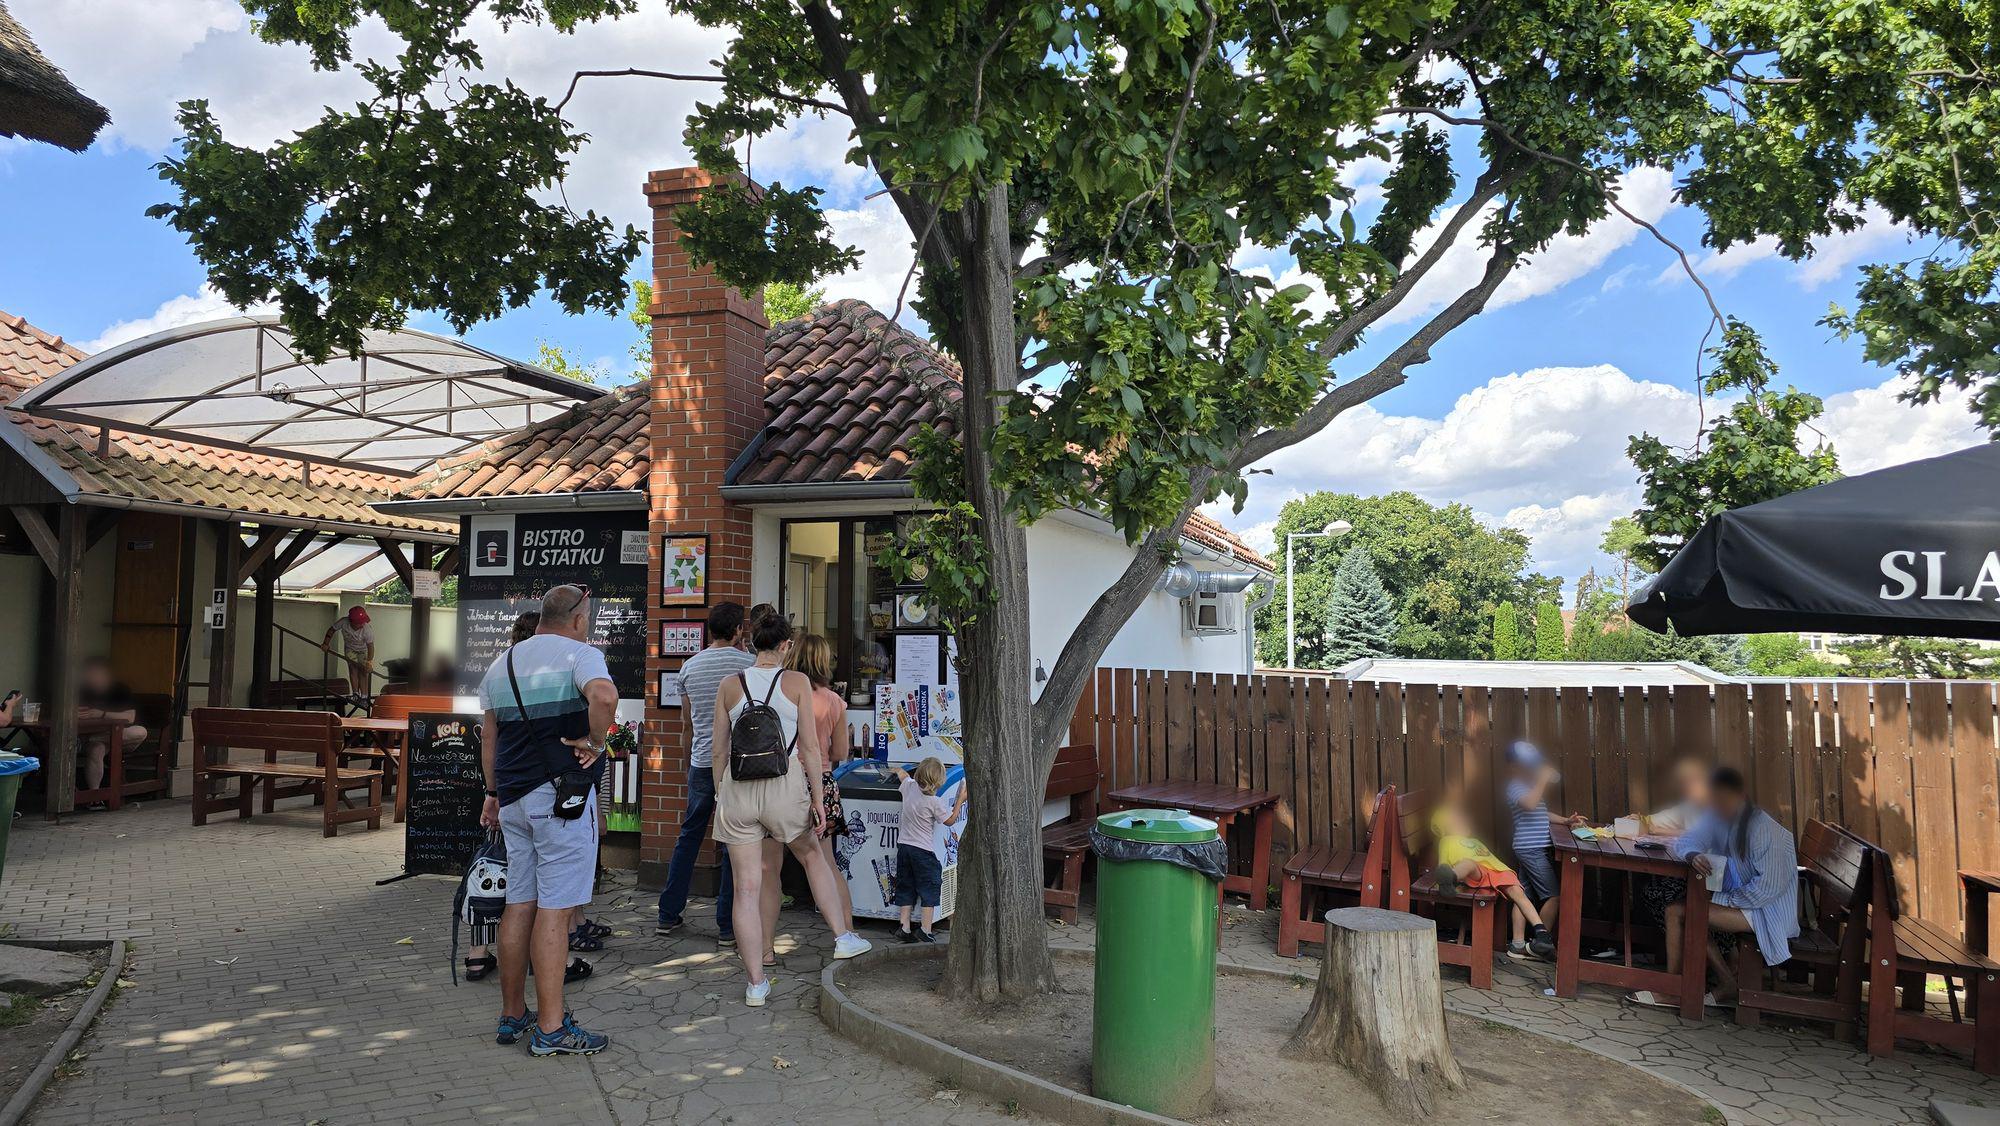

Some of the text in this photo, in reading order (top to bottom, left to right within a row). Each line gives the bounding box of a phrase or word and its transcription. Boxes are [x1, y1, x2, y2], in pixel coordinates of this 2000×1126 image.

[522, 529, 584, 546] BISTRO
[522, 548, 604, 566] U STATKU
[867, 809, 900, 824] jogurtová
